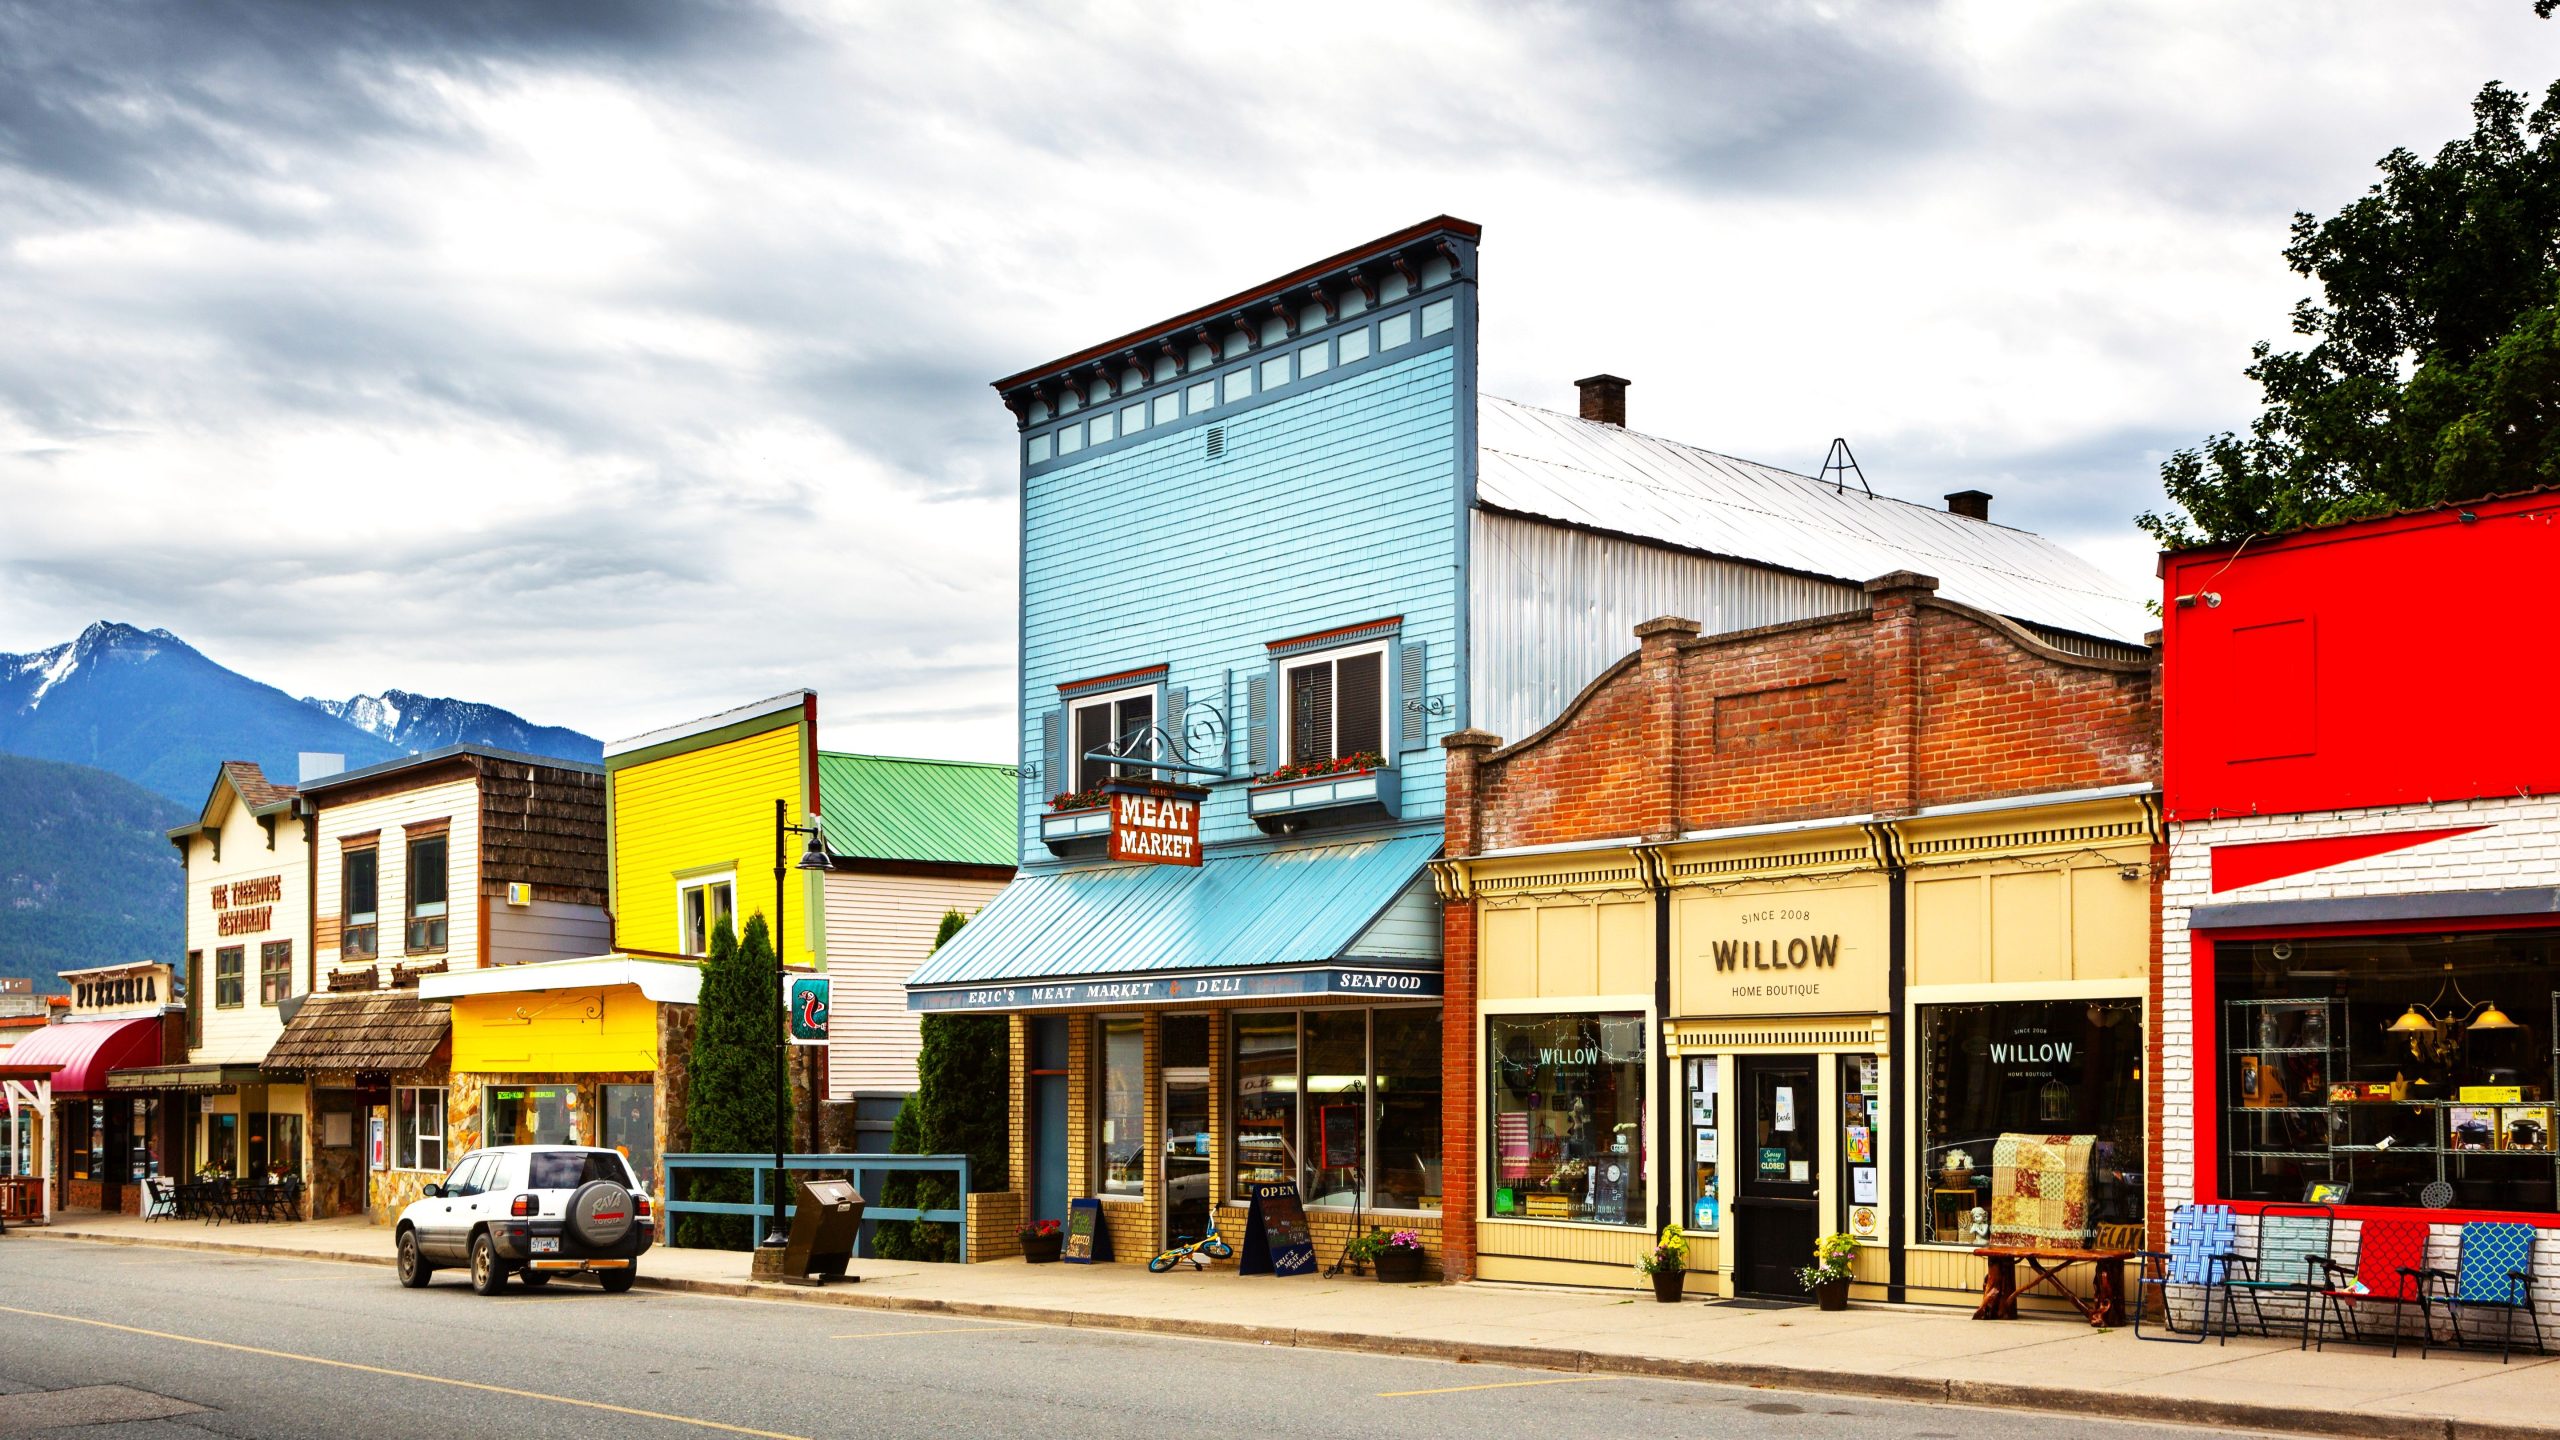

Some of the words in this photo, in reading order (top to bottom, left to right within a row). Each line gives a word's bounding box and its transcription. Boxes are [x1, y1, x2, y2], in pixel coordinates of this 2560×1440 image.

[1120, 793, 1193, 830] MEAT
[1120, 829, 1193, 858] MARKET
[210, 884, 228, 910] THE
[231, 874, 281, 906] TREEHOUSE
[218, 905, 272, 937] RESTAURANT
[1741, 910, 1775, 925] SINCE
[1780, 910, 1810, 921] 2008
[1712, 934, 1839, 972] WILLOW
[968, 988, 1016, 1004] ERIC'S
[1032, 987, 1075, 1001] MEAT
[1087, 983, 1154, 999] MARKET
[1169, 980, 1182, 996] &
[1196, 978, 1241, 994] DELI
[1339, 973, 1421, 990] SEAFOOD
[1732, 986, 1762, 997] HOME
[1766, 984, 1820, 997] BOUTIQUE
[76, 976, 157, 1008] PIZZERIA
[2032, 1027, 2047, 1035] 2008
[1540, 1048, 1598, 1065] WILLOW
[1990, 1042, 2073, 1064] WILLOW
[1764, 1149, 1781, 1160] Sorry
[1761, 1162, 1785, 1170] CLOSED
[1260, 1185, 1295, 1198] OPEN
[1275, 1249, 1294, 1269] ERIC'S
[1284, 1253, 1299, 1269] MEAT
[1291, 1249, 1314, 1271] MARKET
